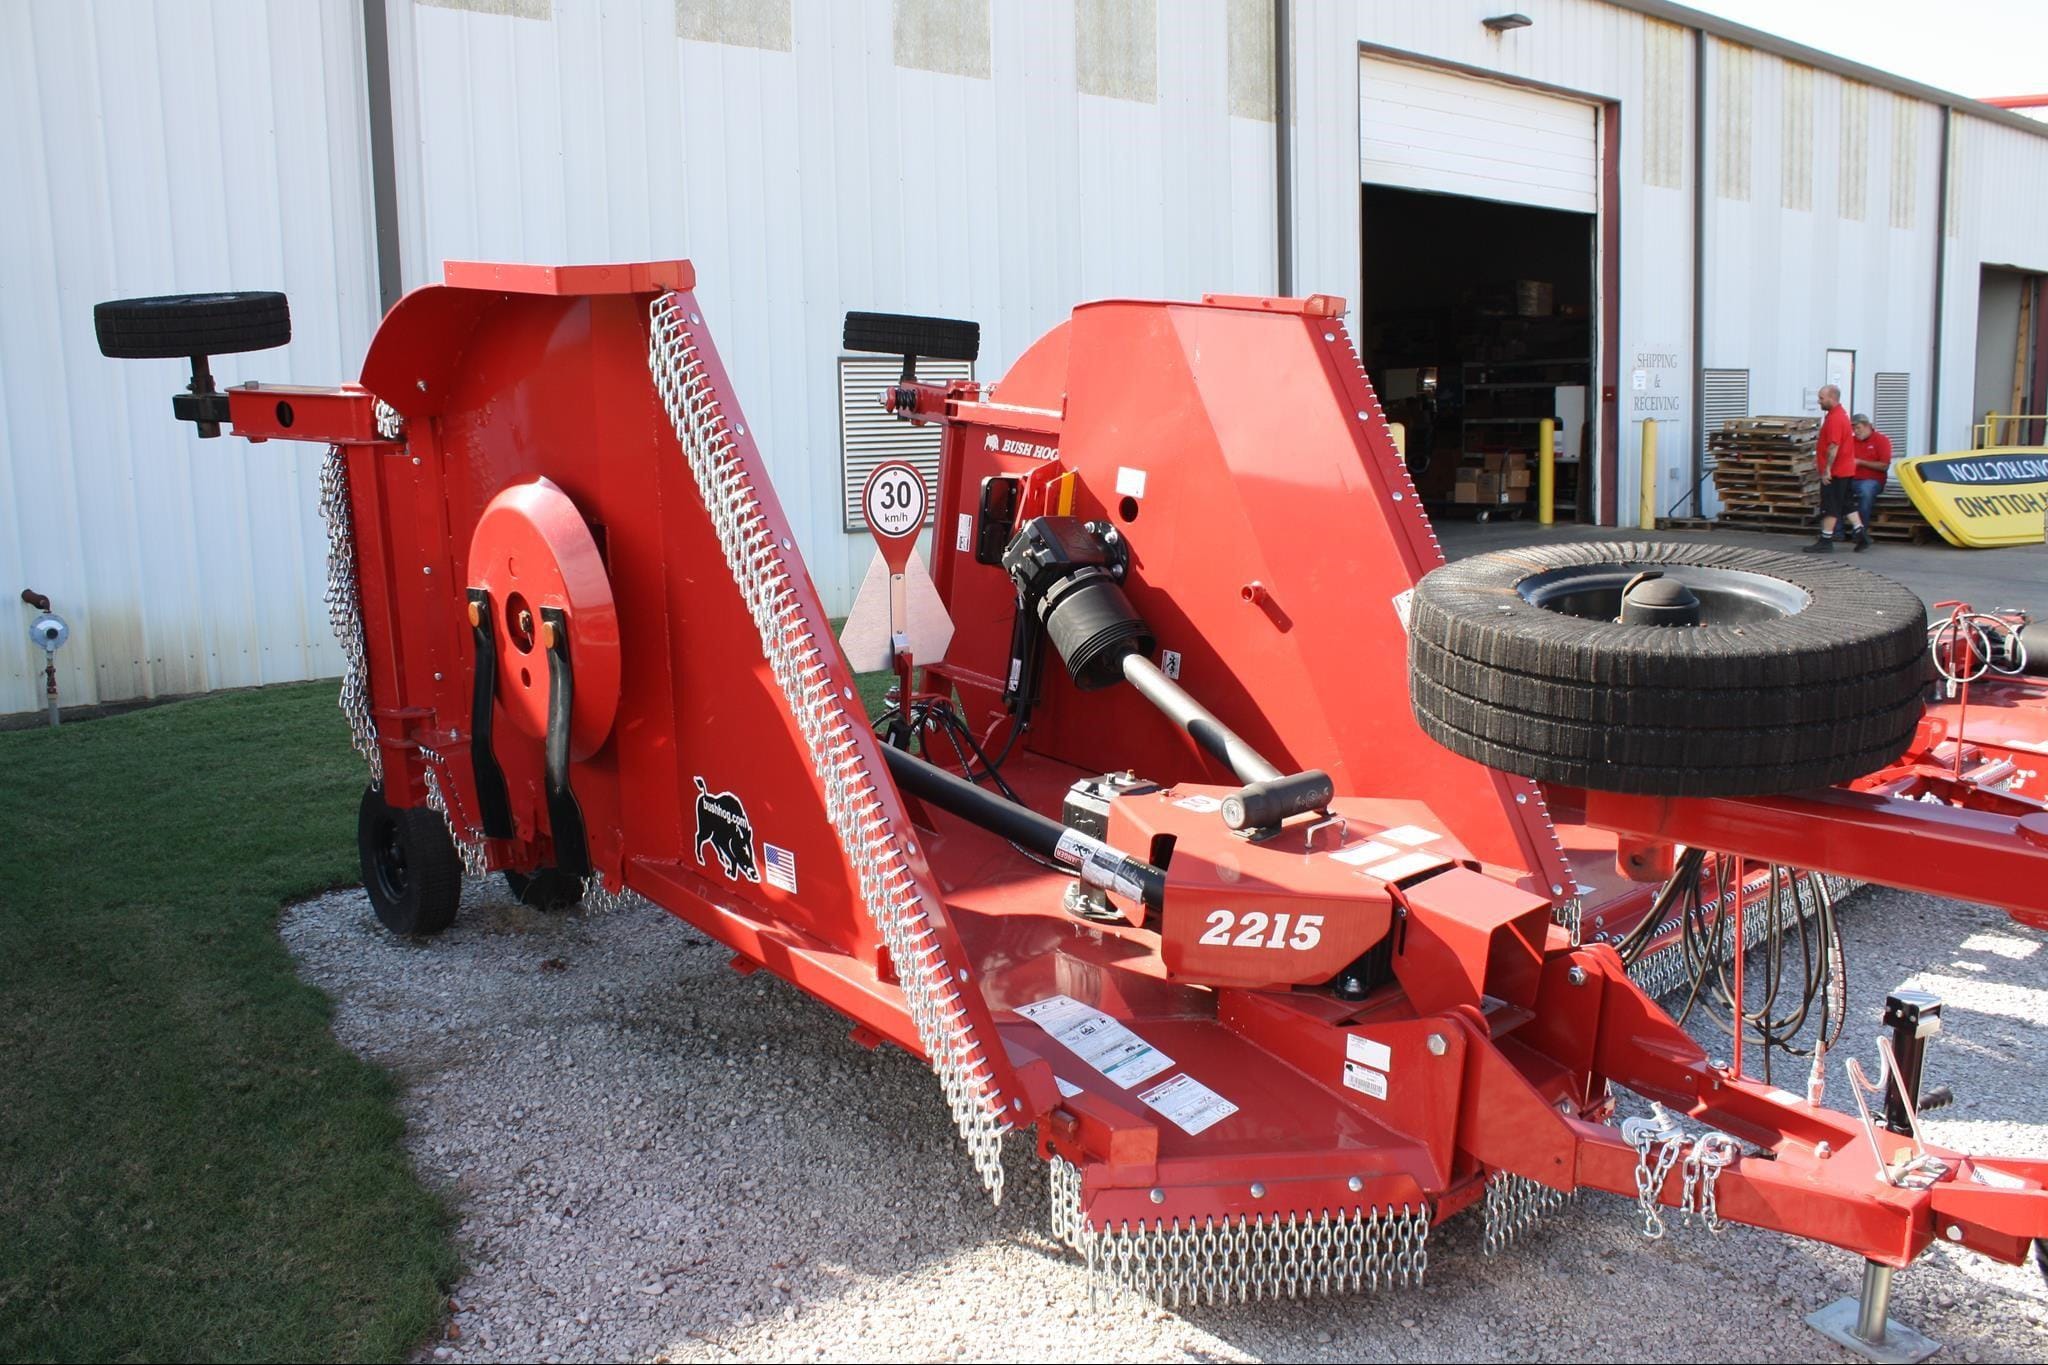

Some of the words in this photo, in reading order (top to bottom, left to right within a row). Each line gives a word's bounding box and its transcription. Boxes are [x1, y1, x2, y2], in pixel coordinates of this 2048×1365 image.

[1637, 353, 1677, 368] SHIPPING
[1654, 373, 1662, 388] &
[1633, 396, 1680, 411] RECEIVING
[1001, 439, 1034, 457] BUSH
[1032, 445, 1060, 461] HOG
[880, 480, 911, 509] 30
[1954, 493, 2040, 517] HOLLAND
[884, 512, 908, 523] km/h
[702, 796, 748, 829] bushhog.com
[1198, 909, 1325, 951] 2215
